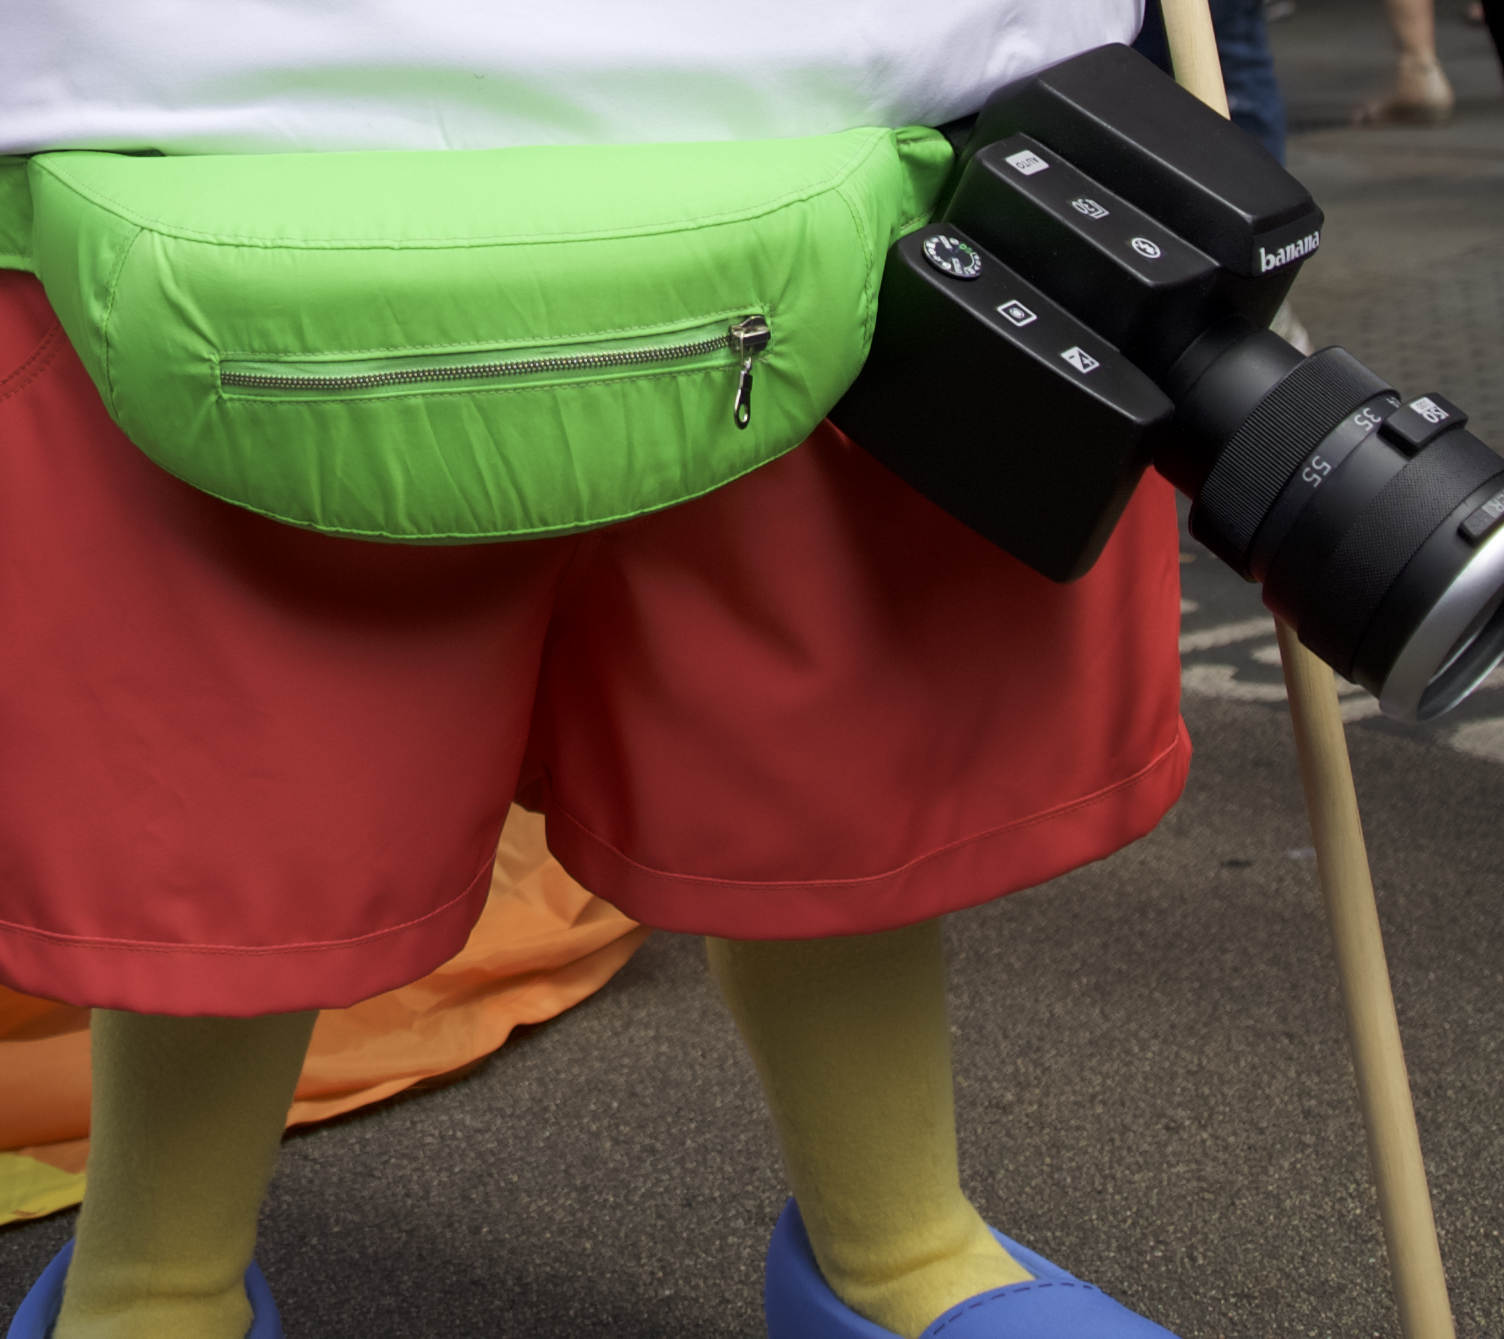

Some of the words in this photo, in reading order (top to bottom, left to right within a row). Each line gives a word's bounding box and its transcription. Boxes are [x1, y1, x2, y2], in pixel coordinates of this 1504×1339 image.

[1259, 230, 1320, 273] banana
[1353, 407, 1382, 432] 35
[1422, 406, 1450, 424] ISO
[1302, 455, 1332, 488] 55
